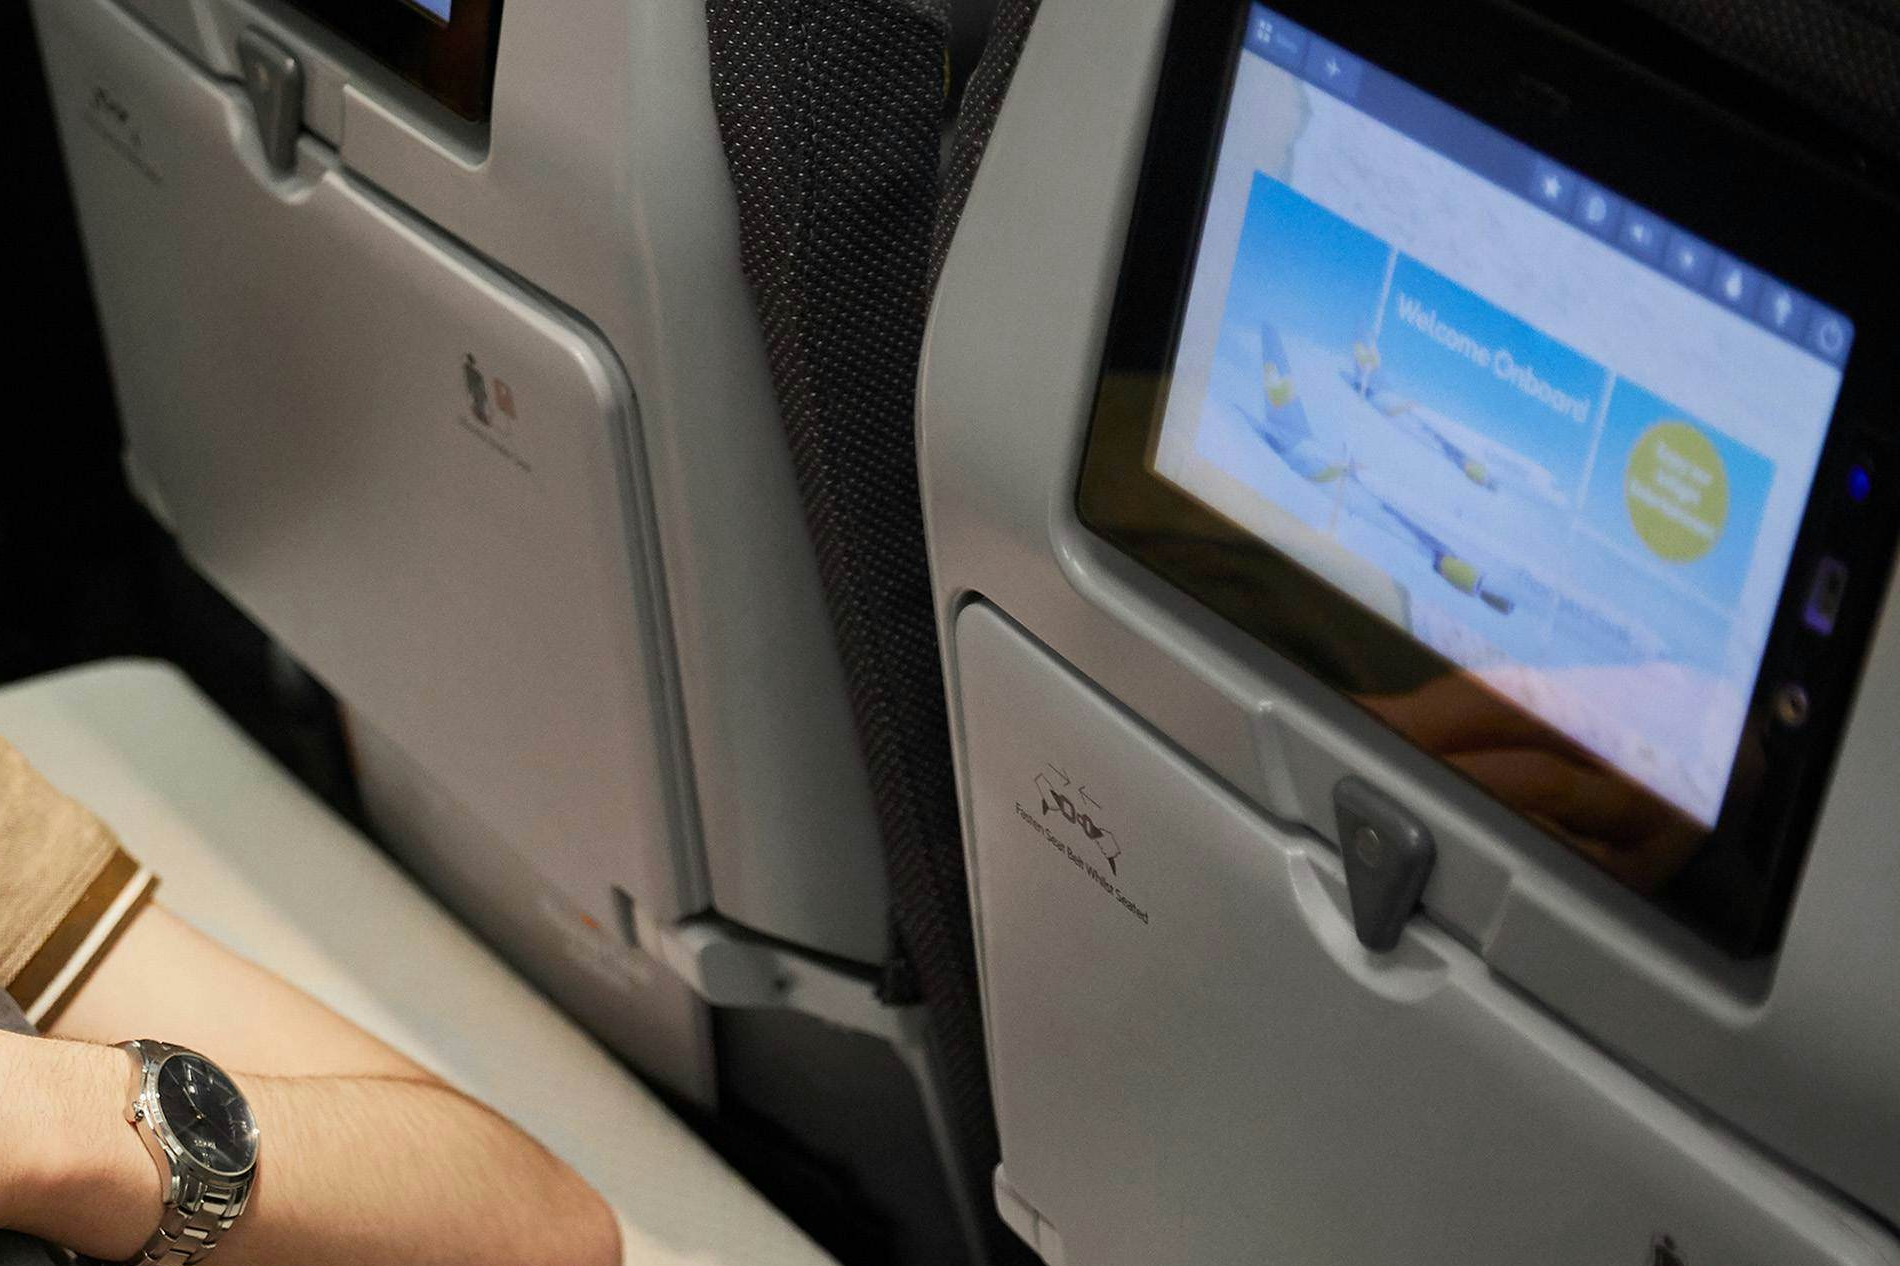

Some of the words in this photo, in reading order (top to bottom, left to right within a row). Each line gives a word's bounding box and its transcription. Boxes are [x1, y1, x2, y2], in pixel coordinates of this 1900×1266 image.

[1398, 290, 1490, 368] Welcome
[1493, 348, 1591, 423] Onboard
[1014, 801, 1045, 836] Fasten
[1045, 828, 1066, 854] Seat
[1115, 888, 1149, 925] Seated
